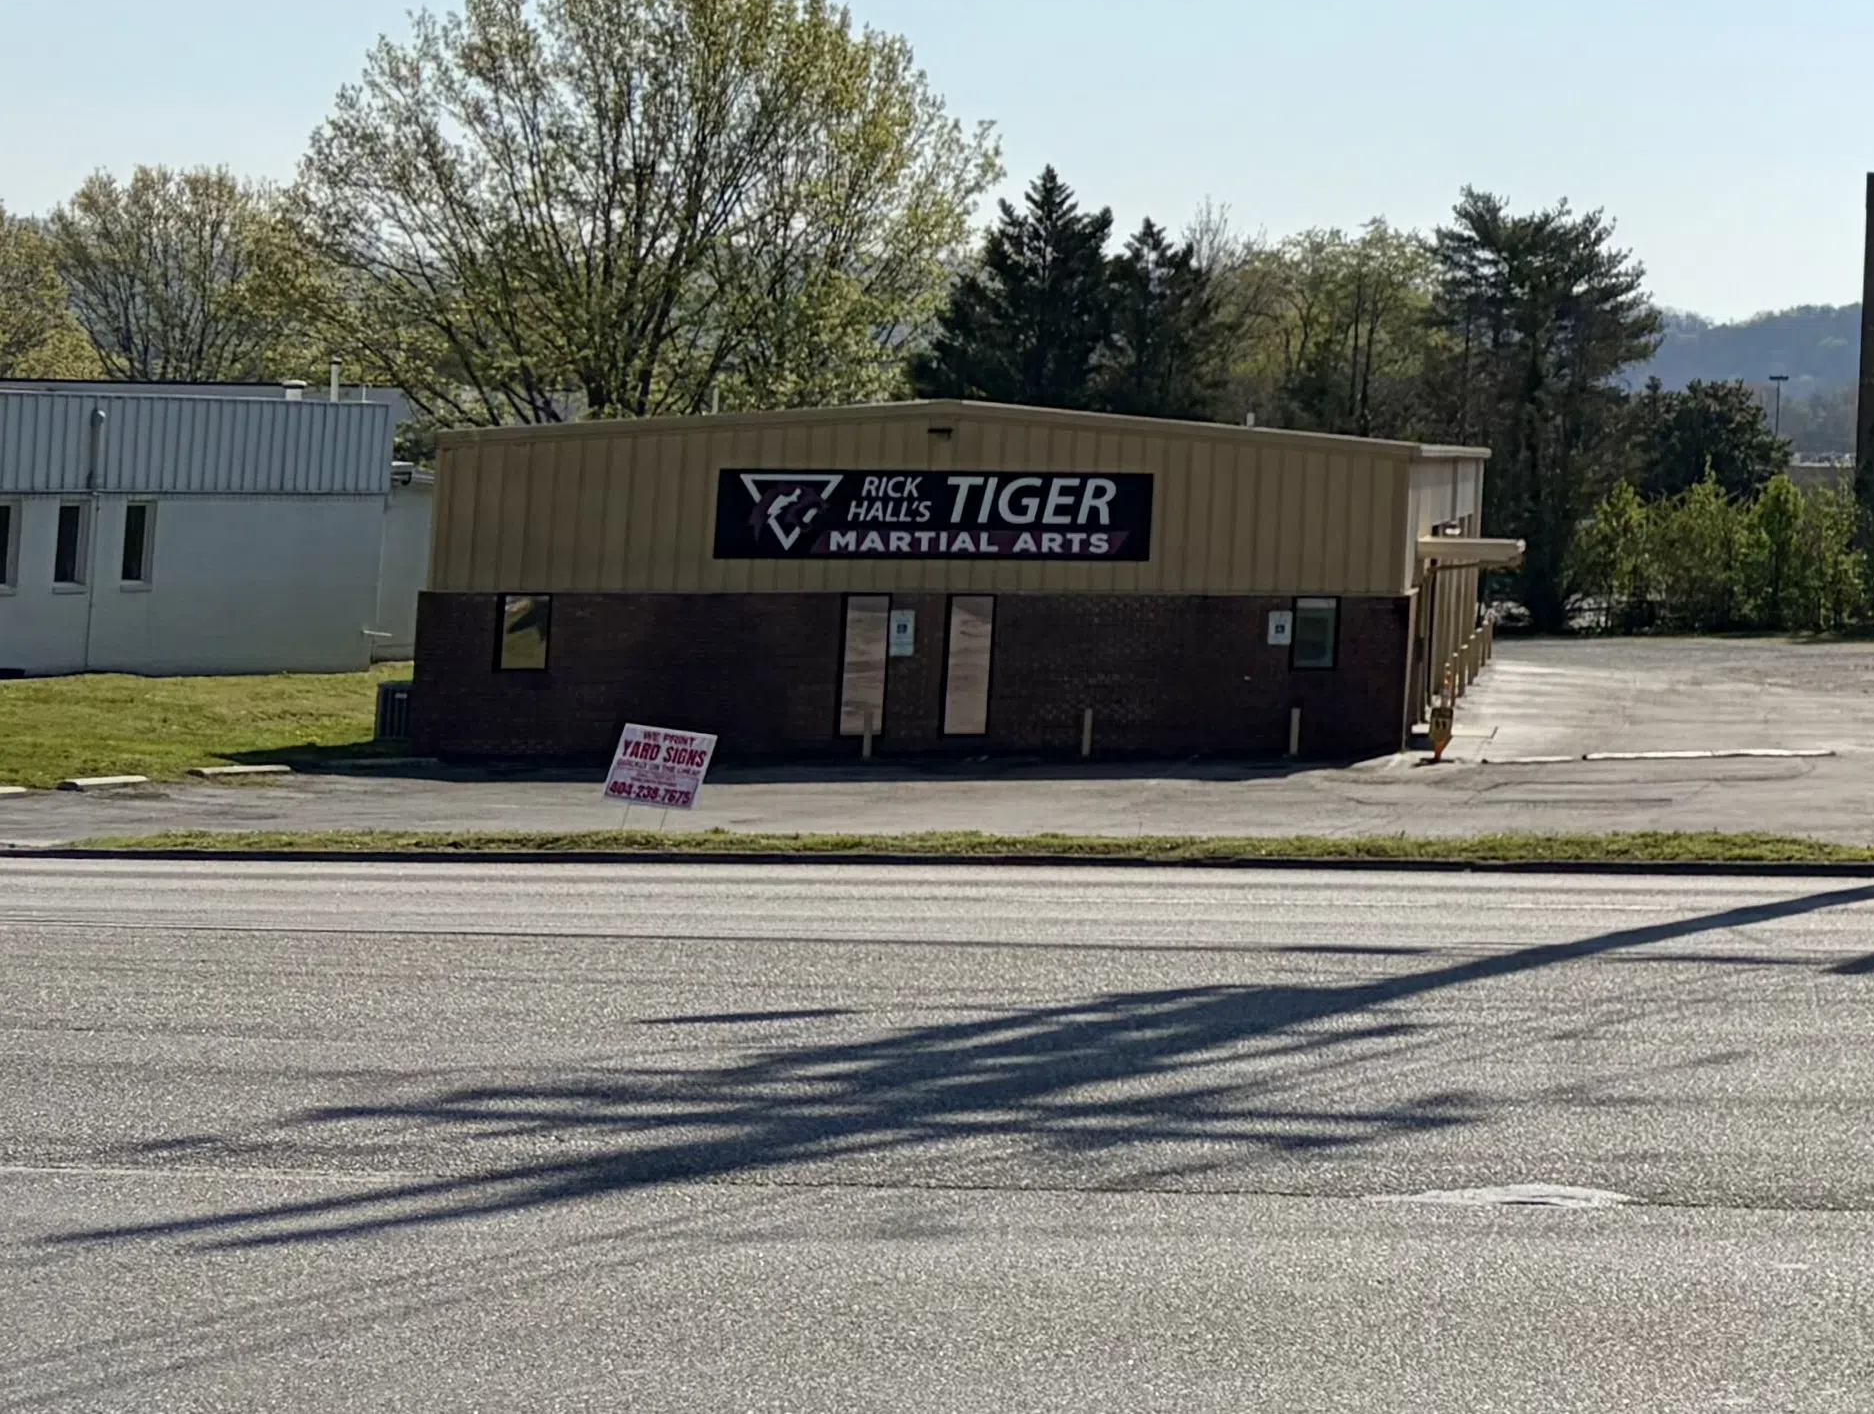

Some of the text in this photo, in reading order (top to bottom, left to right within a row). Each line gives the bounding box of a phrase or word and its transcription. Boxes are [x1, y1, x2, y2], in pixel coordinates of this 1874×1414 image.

[847, 500, 932, 523] HALL'S
[860, 475, 1117, 525] RICK TIGER
[827, 530, 1111, 554] MARTIAL ARTS
[623, 739, 707, 768] YARD SIGNS
